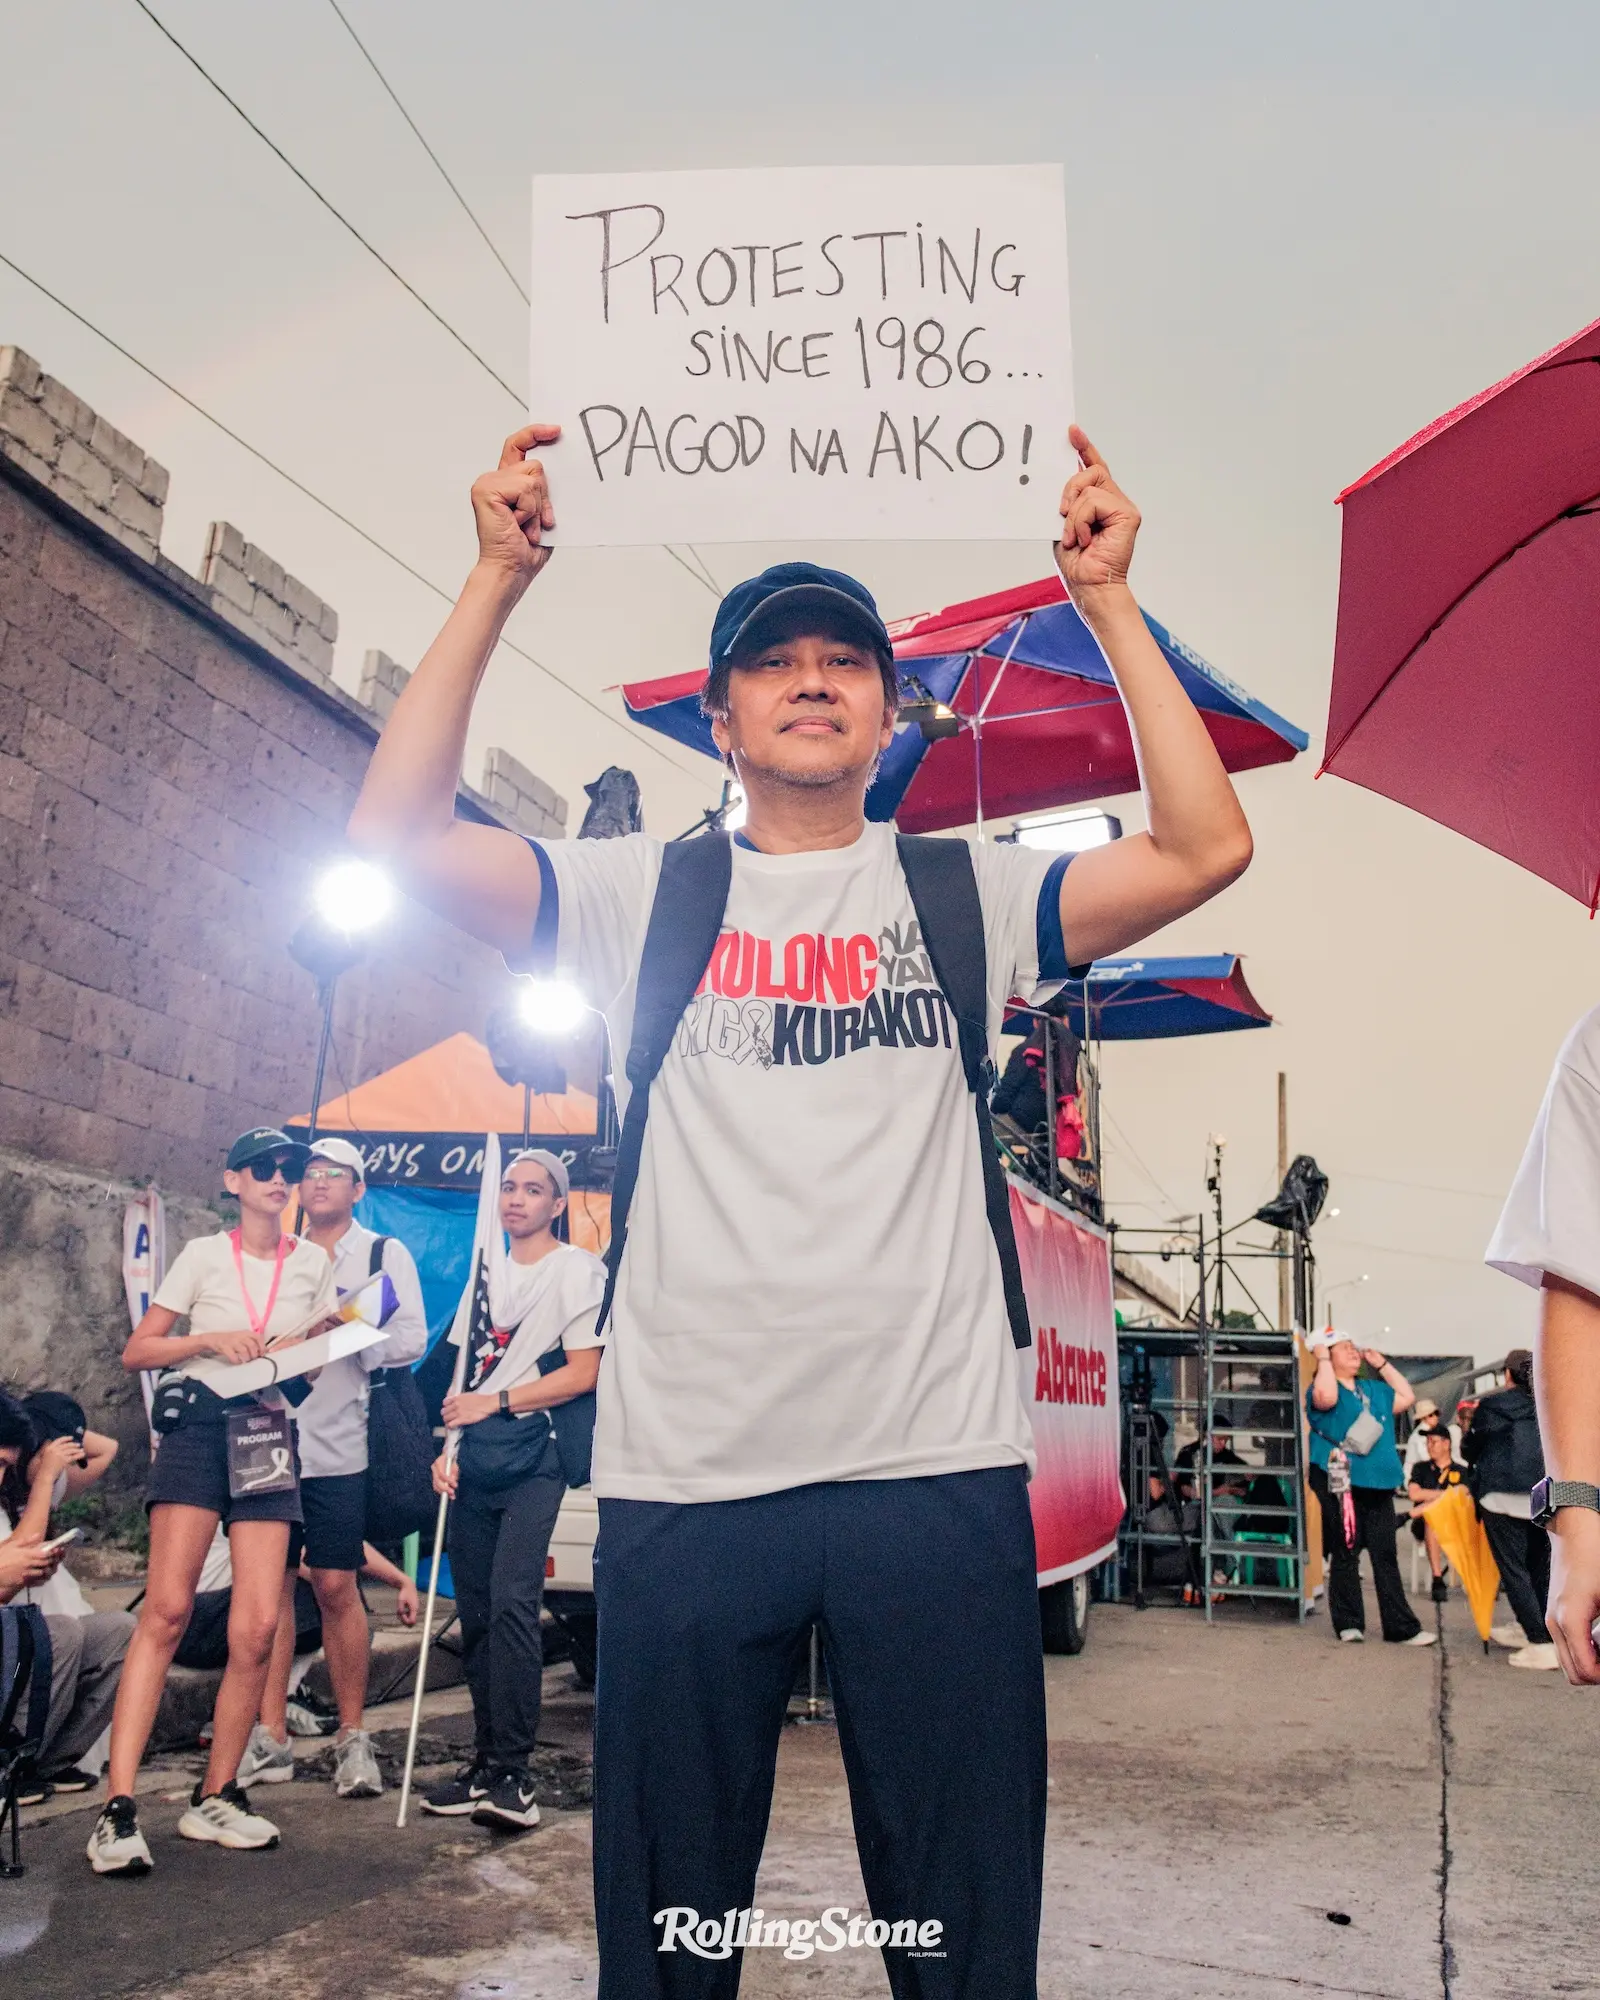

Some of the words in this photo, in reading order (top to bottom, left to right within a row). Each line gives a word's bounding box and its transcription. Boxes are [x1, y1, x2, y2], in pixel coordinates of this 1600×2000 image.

[855, 317, 1043, 389] 1986...
[579, 404, 766, 482] PAGOD
[790, 428, 848, 476] NA
[771, 988, 952, 1066] KURAKOT
[1035, 1327, 1106, 1407] Abante
[237, 1431, 283, 1446] PROGRAM
